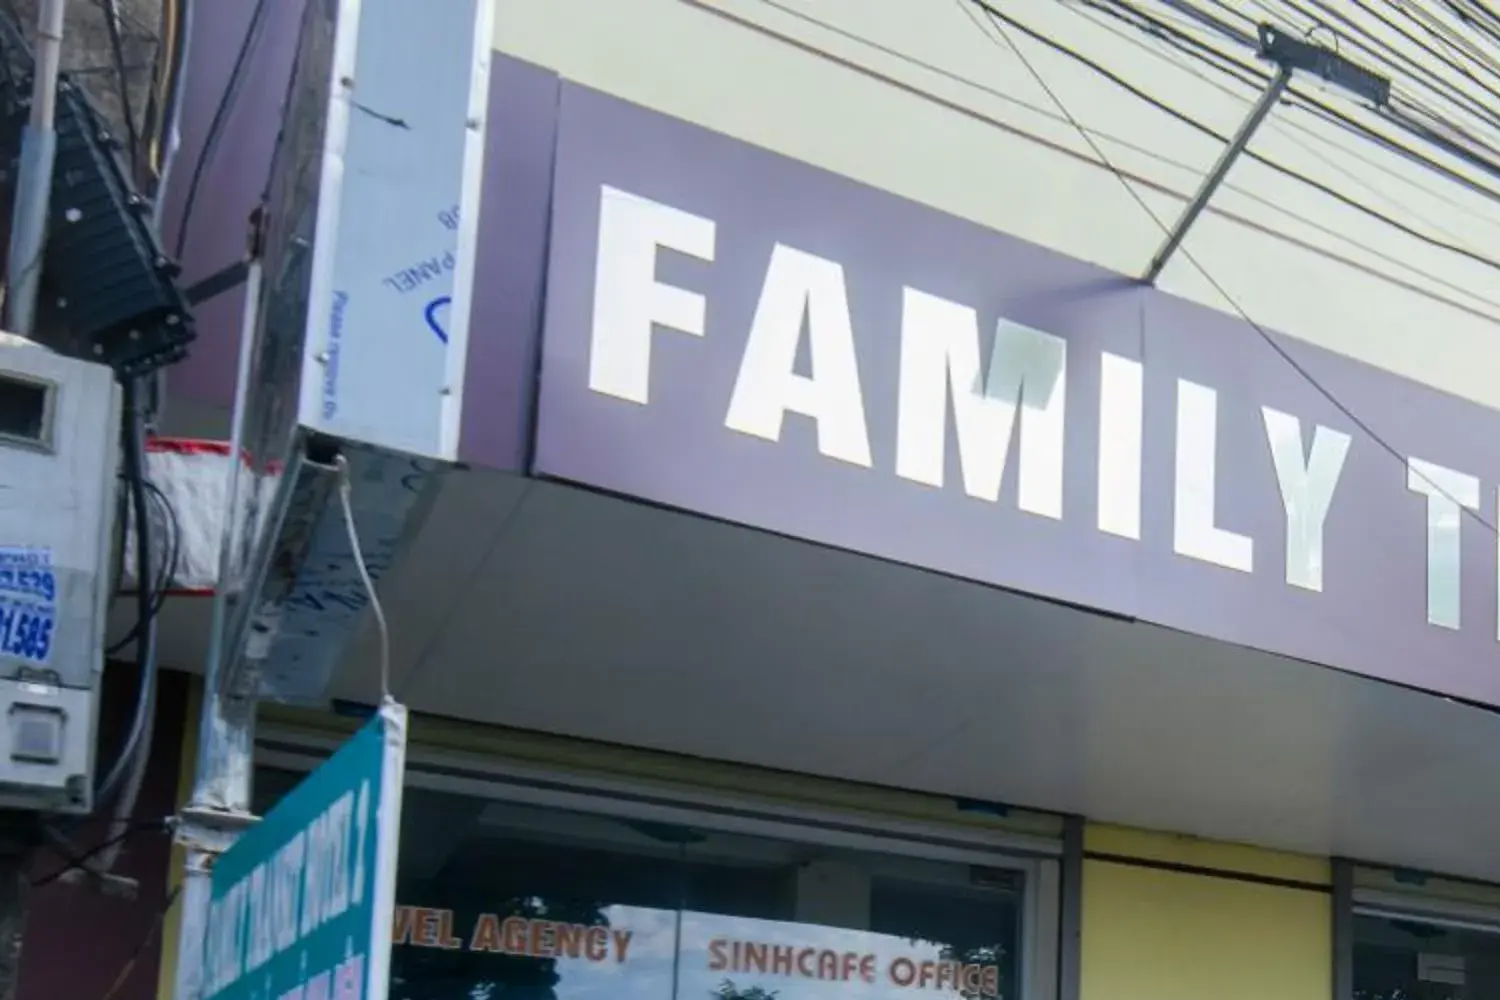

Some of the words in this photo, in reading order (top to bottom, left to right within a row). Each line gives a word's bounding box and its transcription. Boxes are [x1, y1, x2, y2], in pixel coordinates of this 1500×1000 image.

[589, 184, 1352, 592] FAMILY
[470, 912, 633, 963] AGENCY
[708, 939, 877, 983] SINHCAFE
[888, 956, 999, 998] OFFICE
